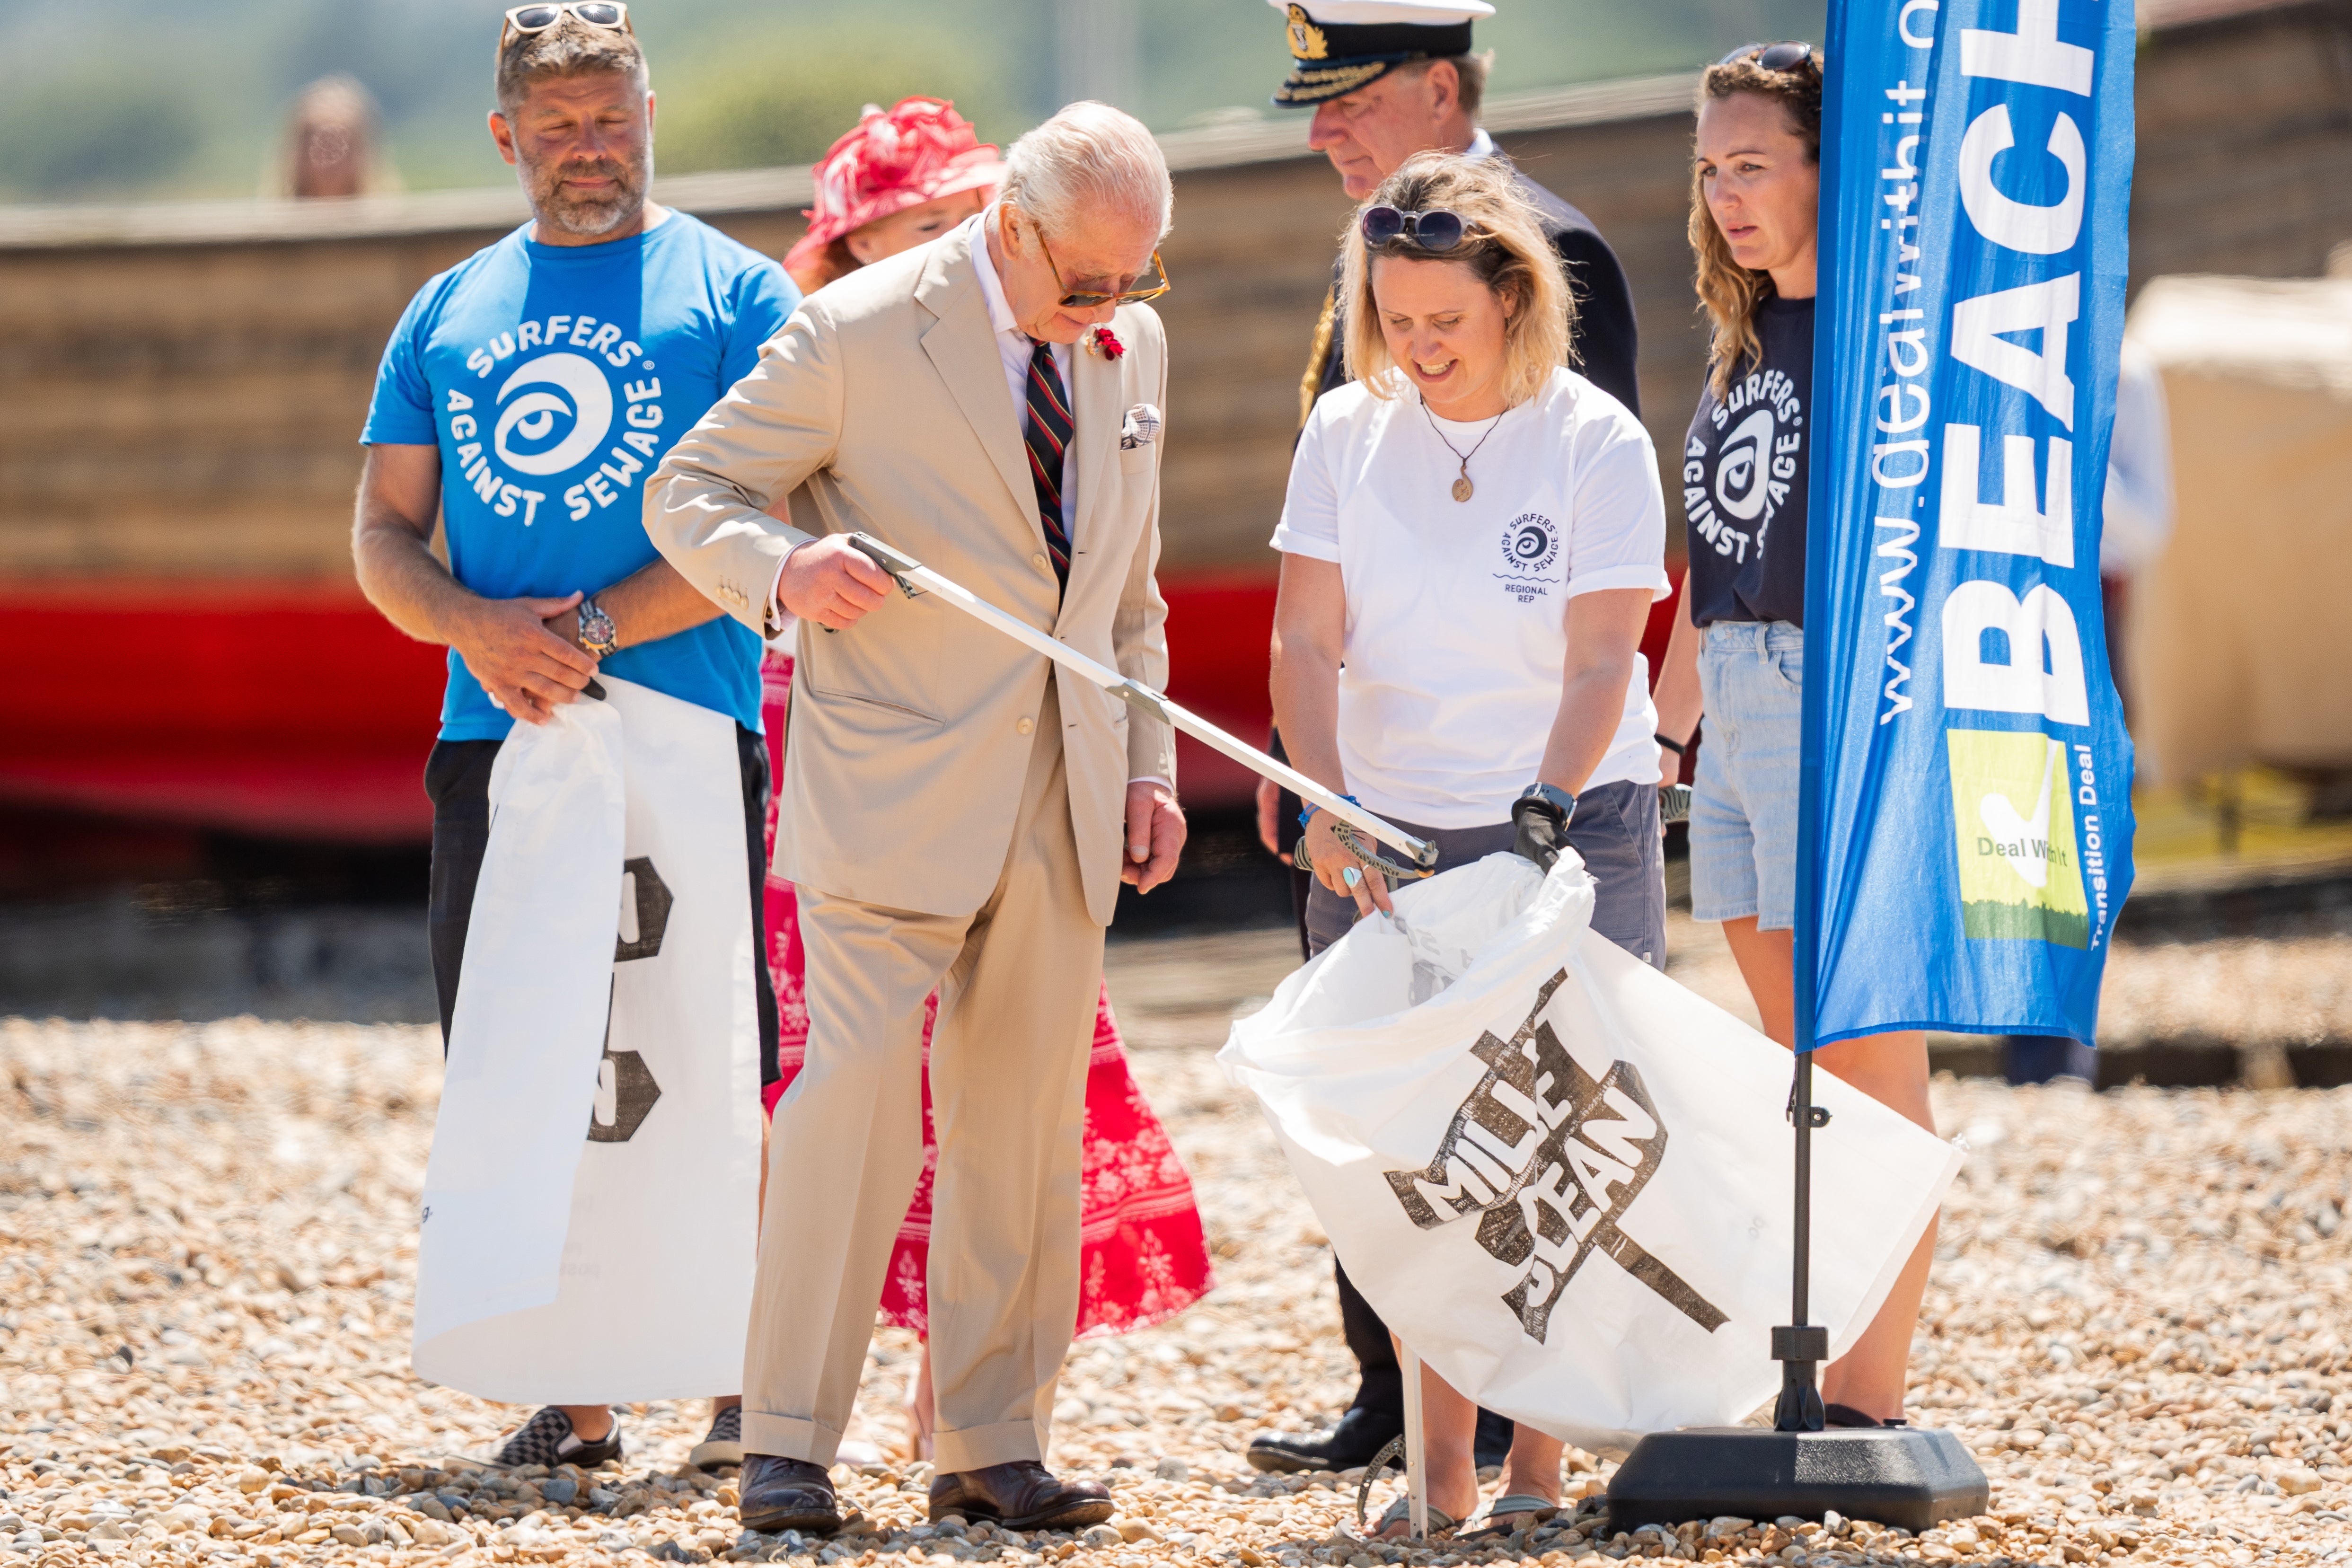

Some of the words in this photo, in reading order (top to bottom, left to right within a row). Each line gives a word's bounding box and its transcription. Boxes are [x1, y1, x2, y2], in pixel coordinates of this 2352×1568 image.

[1940, 0, 2098, 726] BEACH
[447, 389, 546, 526] AGAINST
[564, 377, 663, 521] SEWAGE
[1683, 436, 1750, 564] AGAINST
[1501, 532, 1528, 572] AGAINST
[1533, 537, 1559, 572] SEWAGE
[1505, 584, 1548, 595] REGIONAL
[1518, 595, 1534, 603] REP
[2074, 744, 2097, 805] Deal
[1977, 837, 2026, 857] Deal
[2084, 815, 2107, 951] Transition
